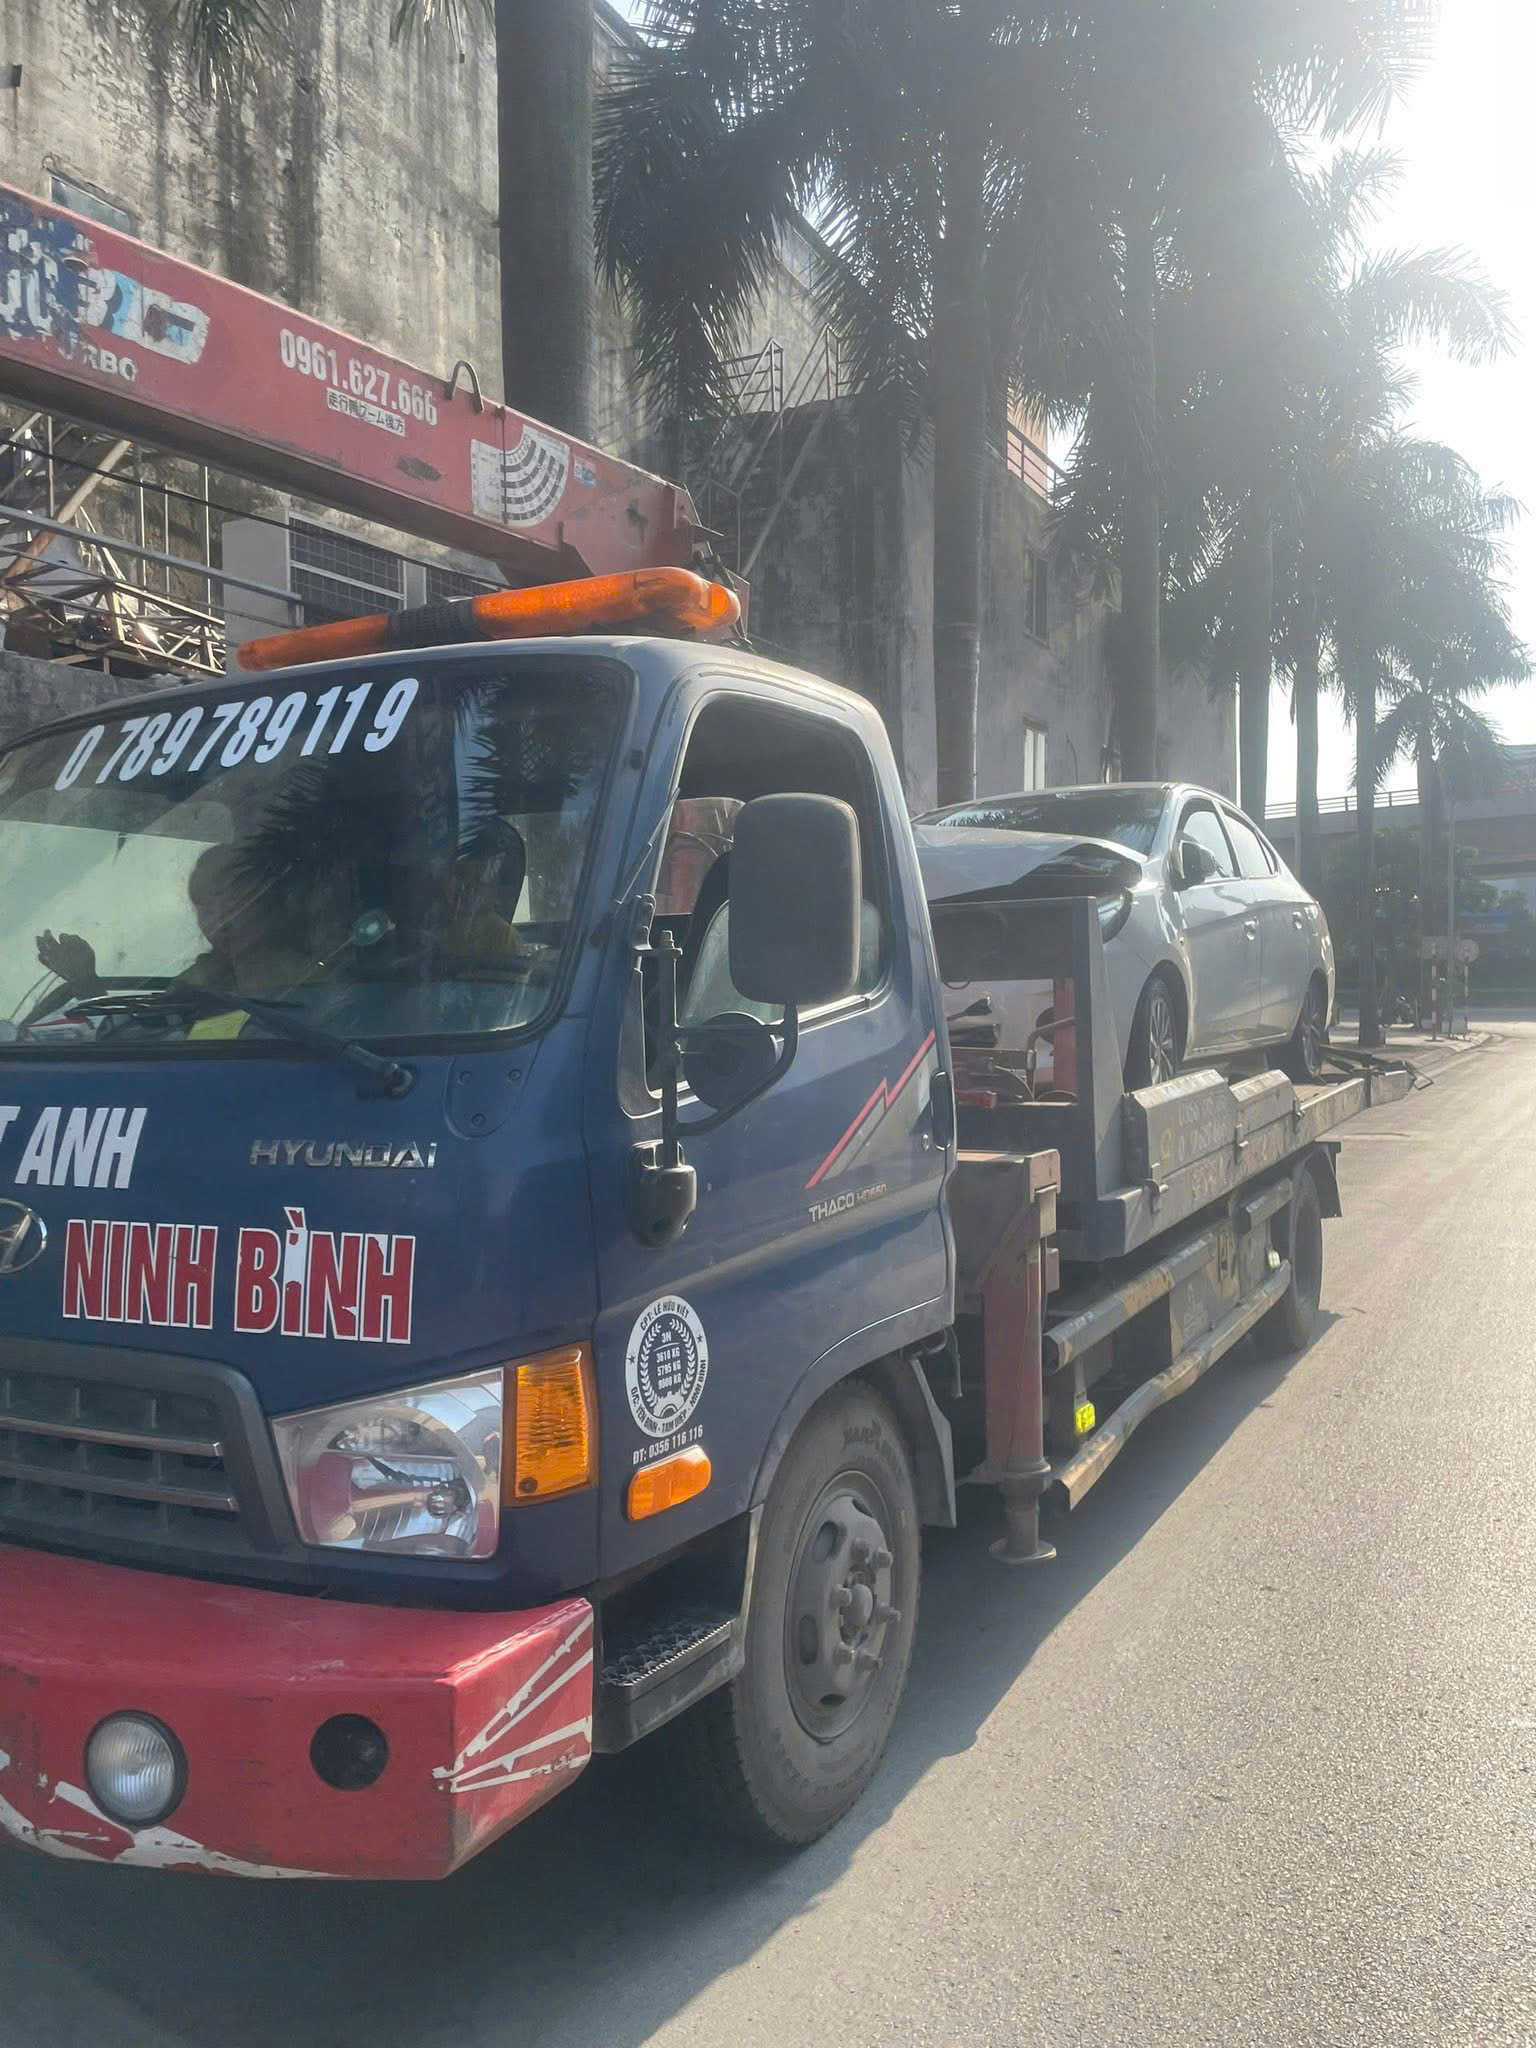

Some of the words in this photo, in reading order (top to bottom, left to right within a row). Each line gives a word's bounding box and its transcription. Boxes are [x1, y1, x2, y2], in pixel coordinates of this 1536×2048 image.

[280, 328, 438, 426] 0961.627.666
[14, 1105, 148, 1189] ANH
[248, 1138, 438, 1169] HYUNDAI
[808, 1191, 855, 1223] THACO
[62, 1218, 219, 1330] NINH
[234, 1206, 416, 1344] BÌNH
[671, 1347, 681, 1359] KG
[672, 1360, 681, 1372] KG
[673, 1373, 681, 1385] KG
[649, 1438, 670, 1458] 0356
[672, 1431, 687, 1449] 116
[689, 1424, 703, 1442] 116
